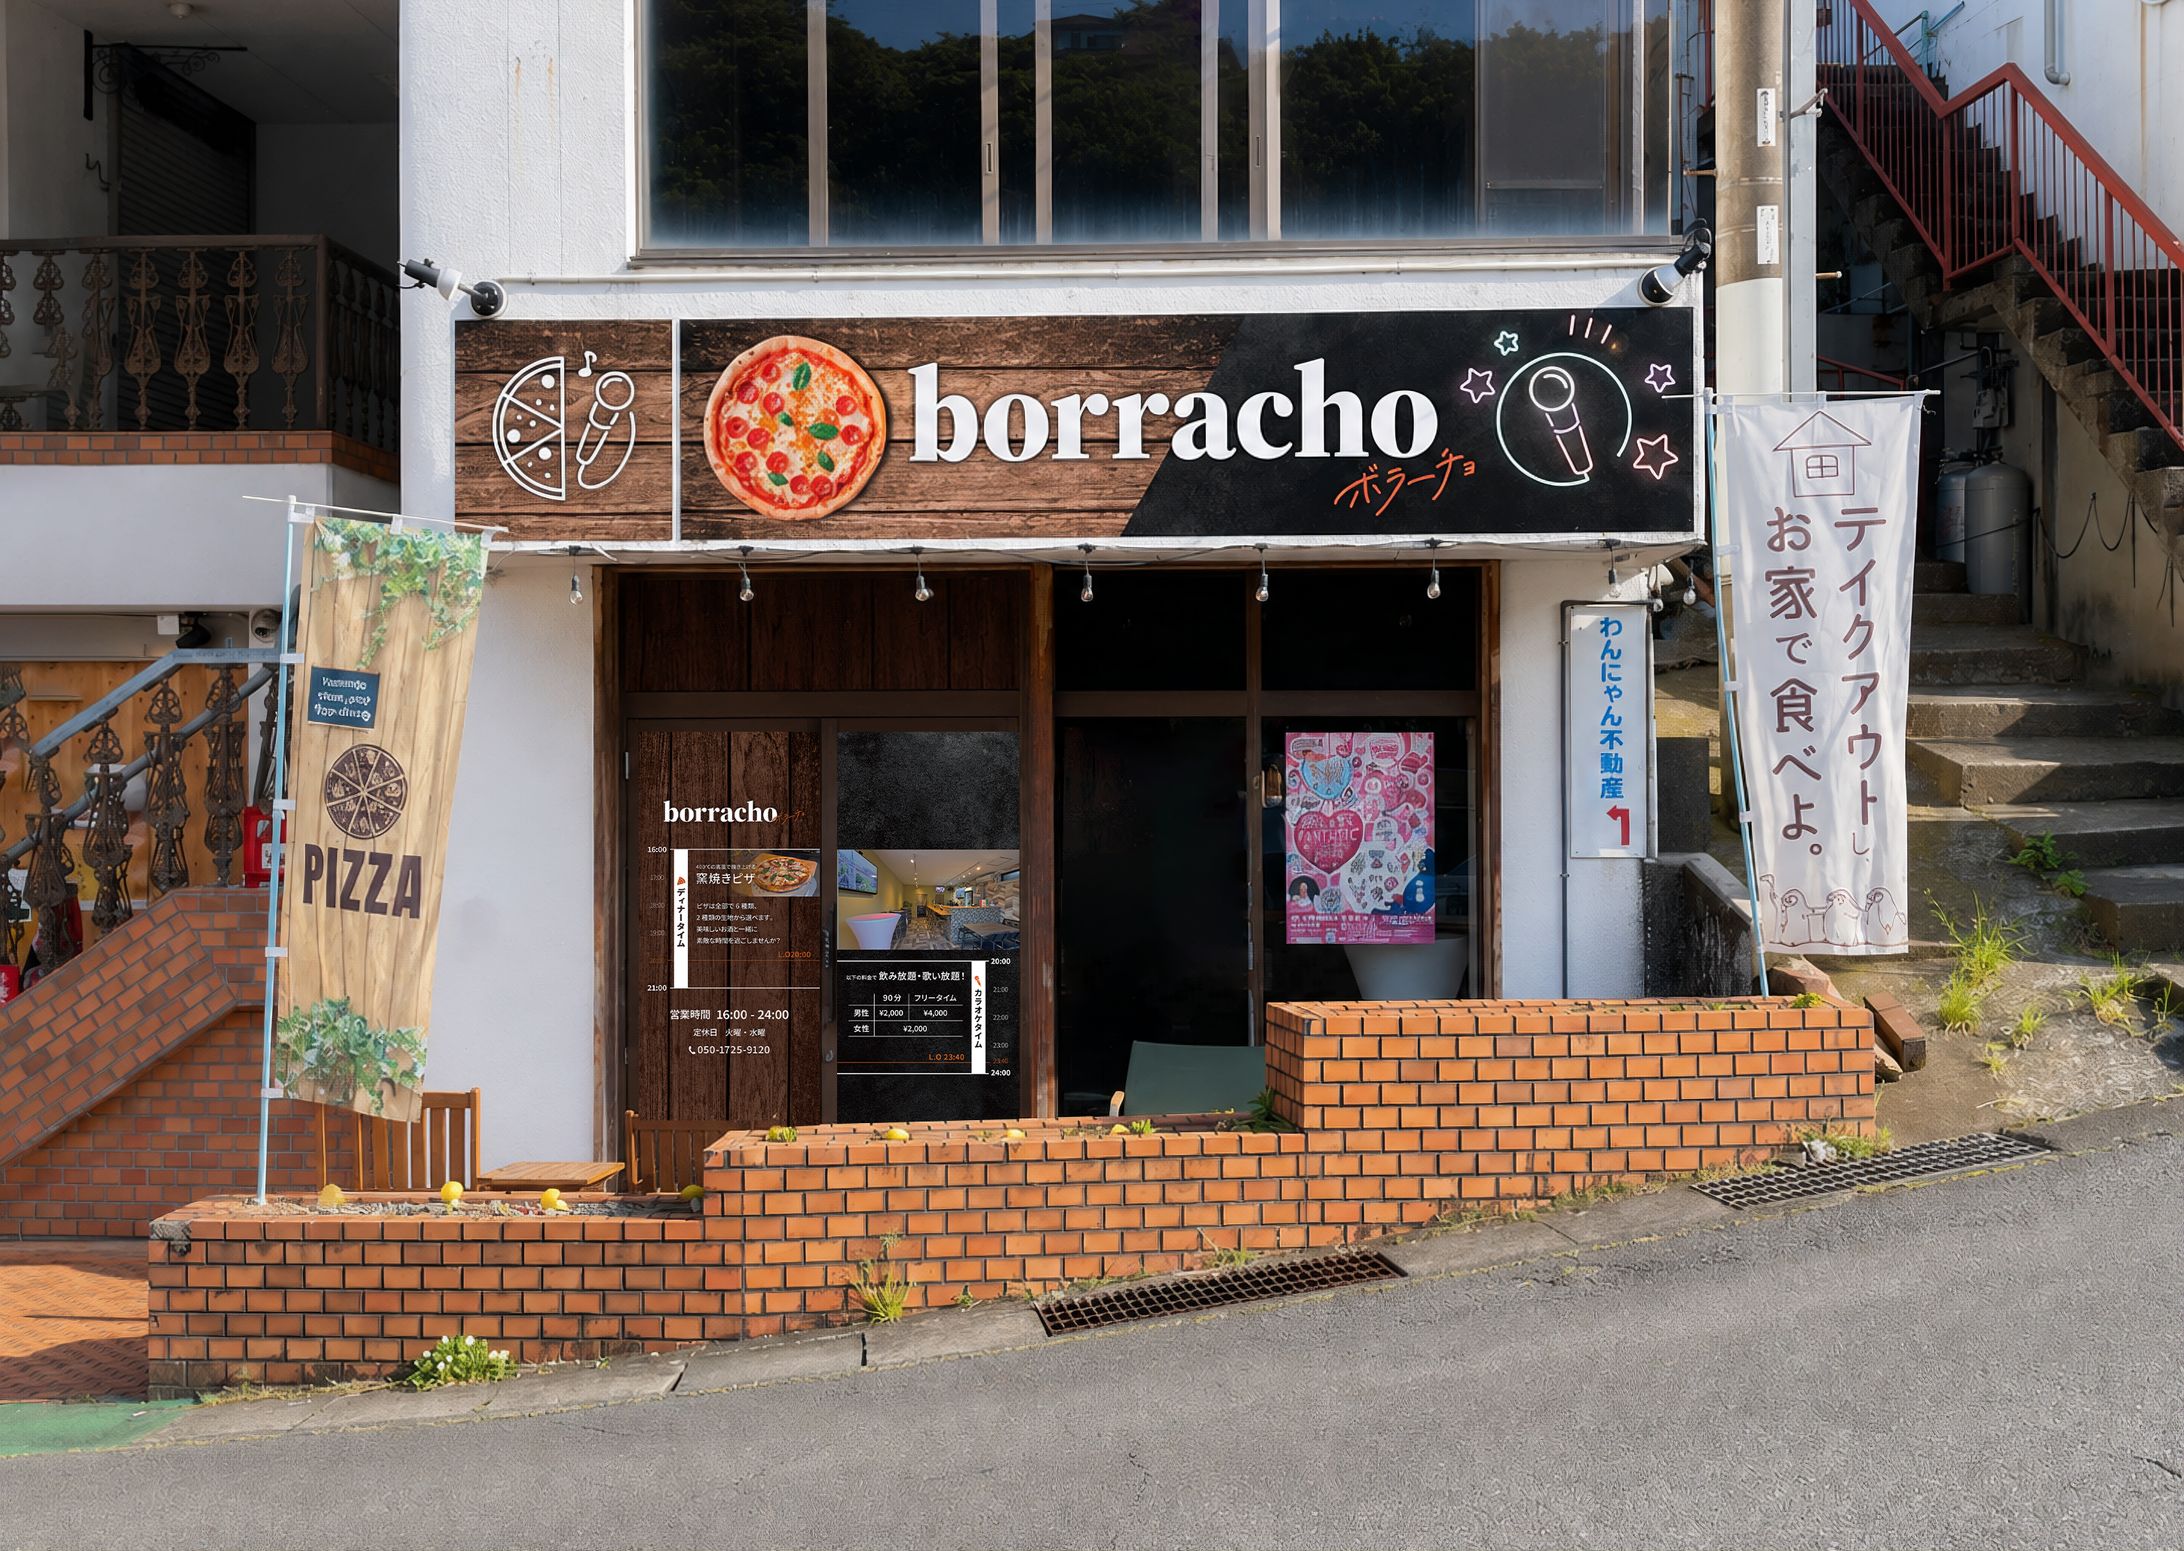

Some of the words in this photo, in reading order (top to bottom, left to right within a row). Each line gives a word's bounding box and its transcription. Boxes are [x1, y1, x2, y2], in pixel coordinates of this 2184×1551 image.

[908, 358, 1438, 462] borracho
[1334, 448, 1476, 517] ボラーチョ
[1764, 506, 1823, 856] お家で食べよ。
[1600, 616, 1624, 799] わんにゃん不動産
[663, 800, 778, 823] borracho
[647, 845, 668, 853] 16:00
[303, 843, 421, 919] PIZZA
[696, 872, 756, 885] 窯焼きピザ
[676, 887, 686, 948] ディナータイム
[647, 984, 667, 992] 21:00
[882, 994, 902, 1002] 90分
[914, 994, 957, 1002] フリータイム
[670, 1009, 711, 1020] 営業時間
[716, 1009, 748, 1020] 16:00
[757, 1009, 789, 1020] 24:00
[853, 1008, 870, 1017] 男性
[879, 1009, 904, 1018] ¥2,000
[923, 1009, 948, 1018] ¥4,000
[974, 988, 983, 1049] カラオケタイム
[693, 1028, 718, 1037] 定休日
[853, 1024, 870, 1033] 女性
[903, 1025, 928, 1034] ¥2,000
[697, 1045, 771, 1055] 050-1725-9120
[928, 1053, 942, 1061] L.O
[943, 1053, 965, 1061] 23:40
[991, 1069, 1011, 1077] 24:00
